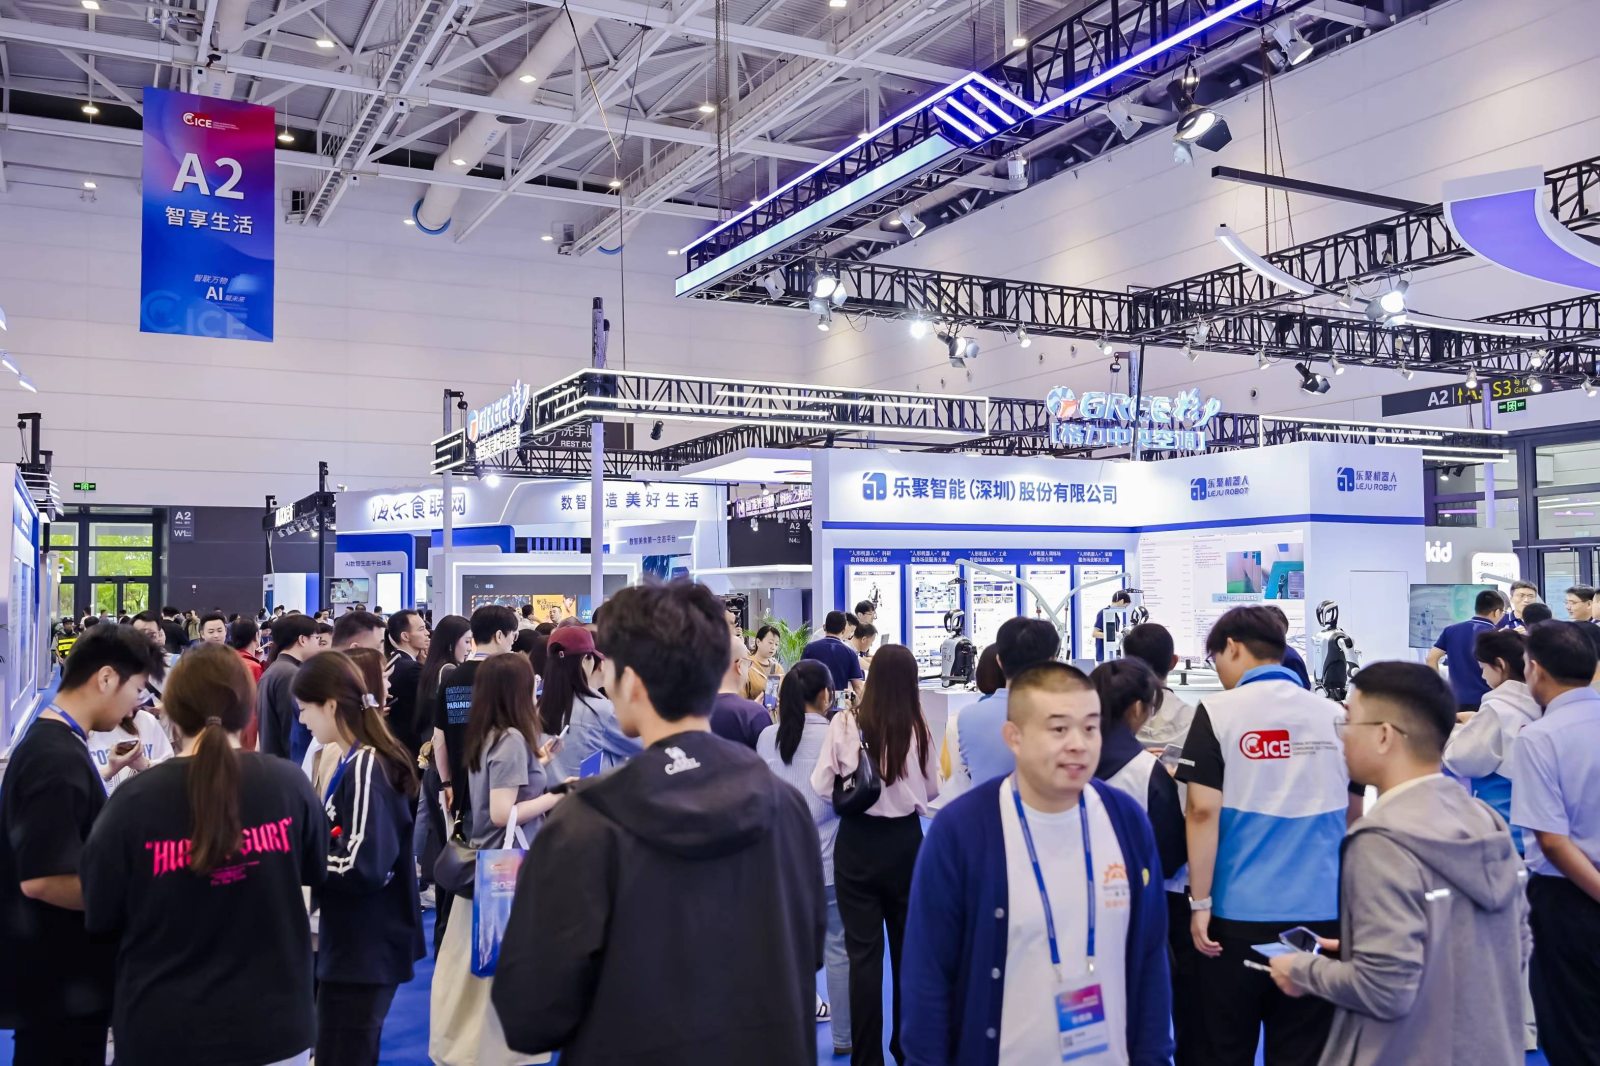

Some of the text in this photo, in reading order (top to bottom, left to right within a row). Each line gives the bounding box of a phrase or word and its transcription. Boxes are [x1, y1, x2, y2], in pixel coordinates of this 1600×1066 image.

[172, 152, 244, 200] A2
[165, 206, 253, 235] 智享生活
[205, 286, 223, 301] AI
[1428, 390, 1449, 407] A2
[1493, 380, 1512, 398] S3
[1514, 386, 1529, 394] Gate
[1208, 475, 1249, 488] 乐聚机器人
[1356, 470, 1398, 483] 乐聚机器人
[893, 477, 1117, 504] 乐聚智能(深圳)股份有限公司
[1208, 487, 1249, 498] LEJU ROBOT
[561, 492, 699, 511] 数智造美好生活
[175, 511, 191, 520] A2
[789, 522, 800, 530] A2
[1425, 540, 1452, 563] kid
[1241, 733, 1290, 758] CICE
